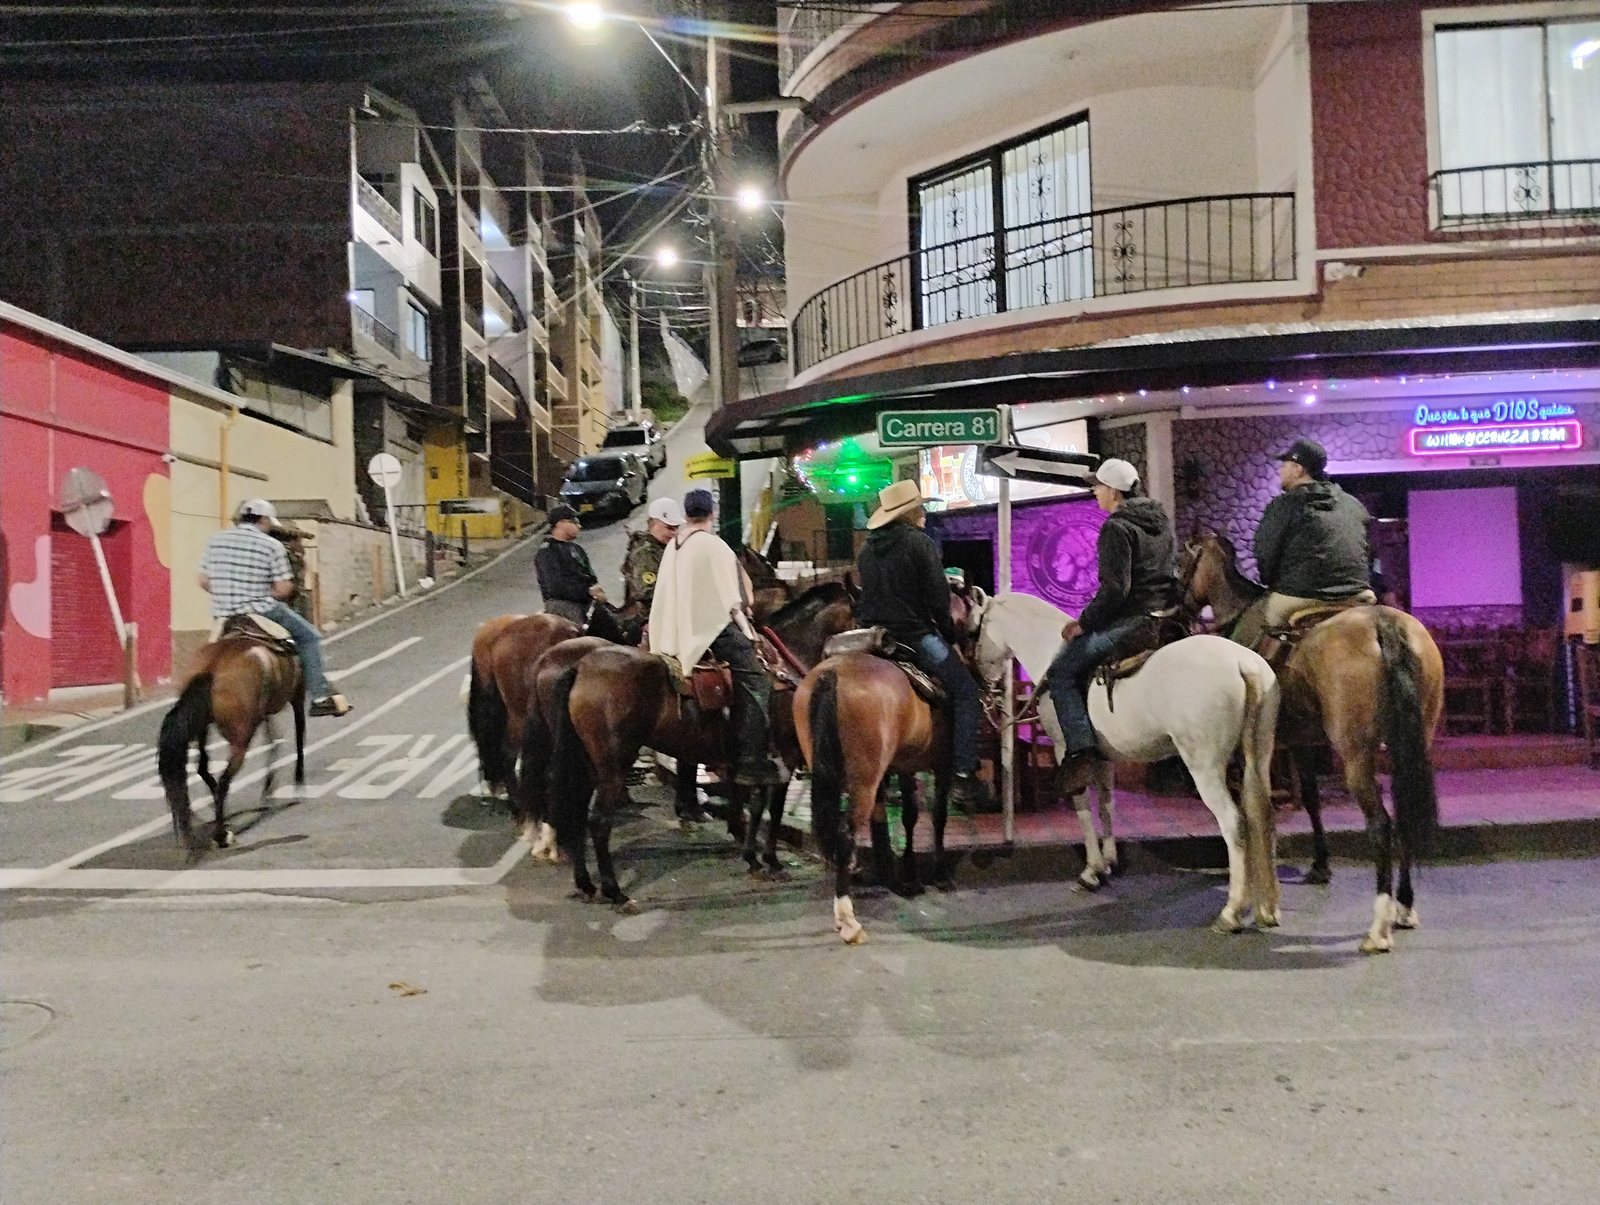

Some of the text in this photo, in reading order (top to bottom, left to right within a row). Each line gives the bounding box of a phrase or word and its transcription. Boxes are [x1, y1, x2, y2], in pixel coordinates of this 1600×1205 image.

[1493, 399, 1539, 422] DIOS
[886, 416, 996, 438] Carrera 81
